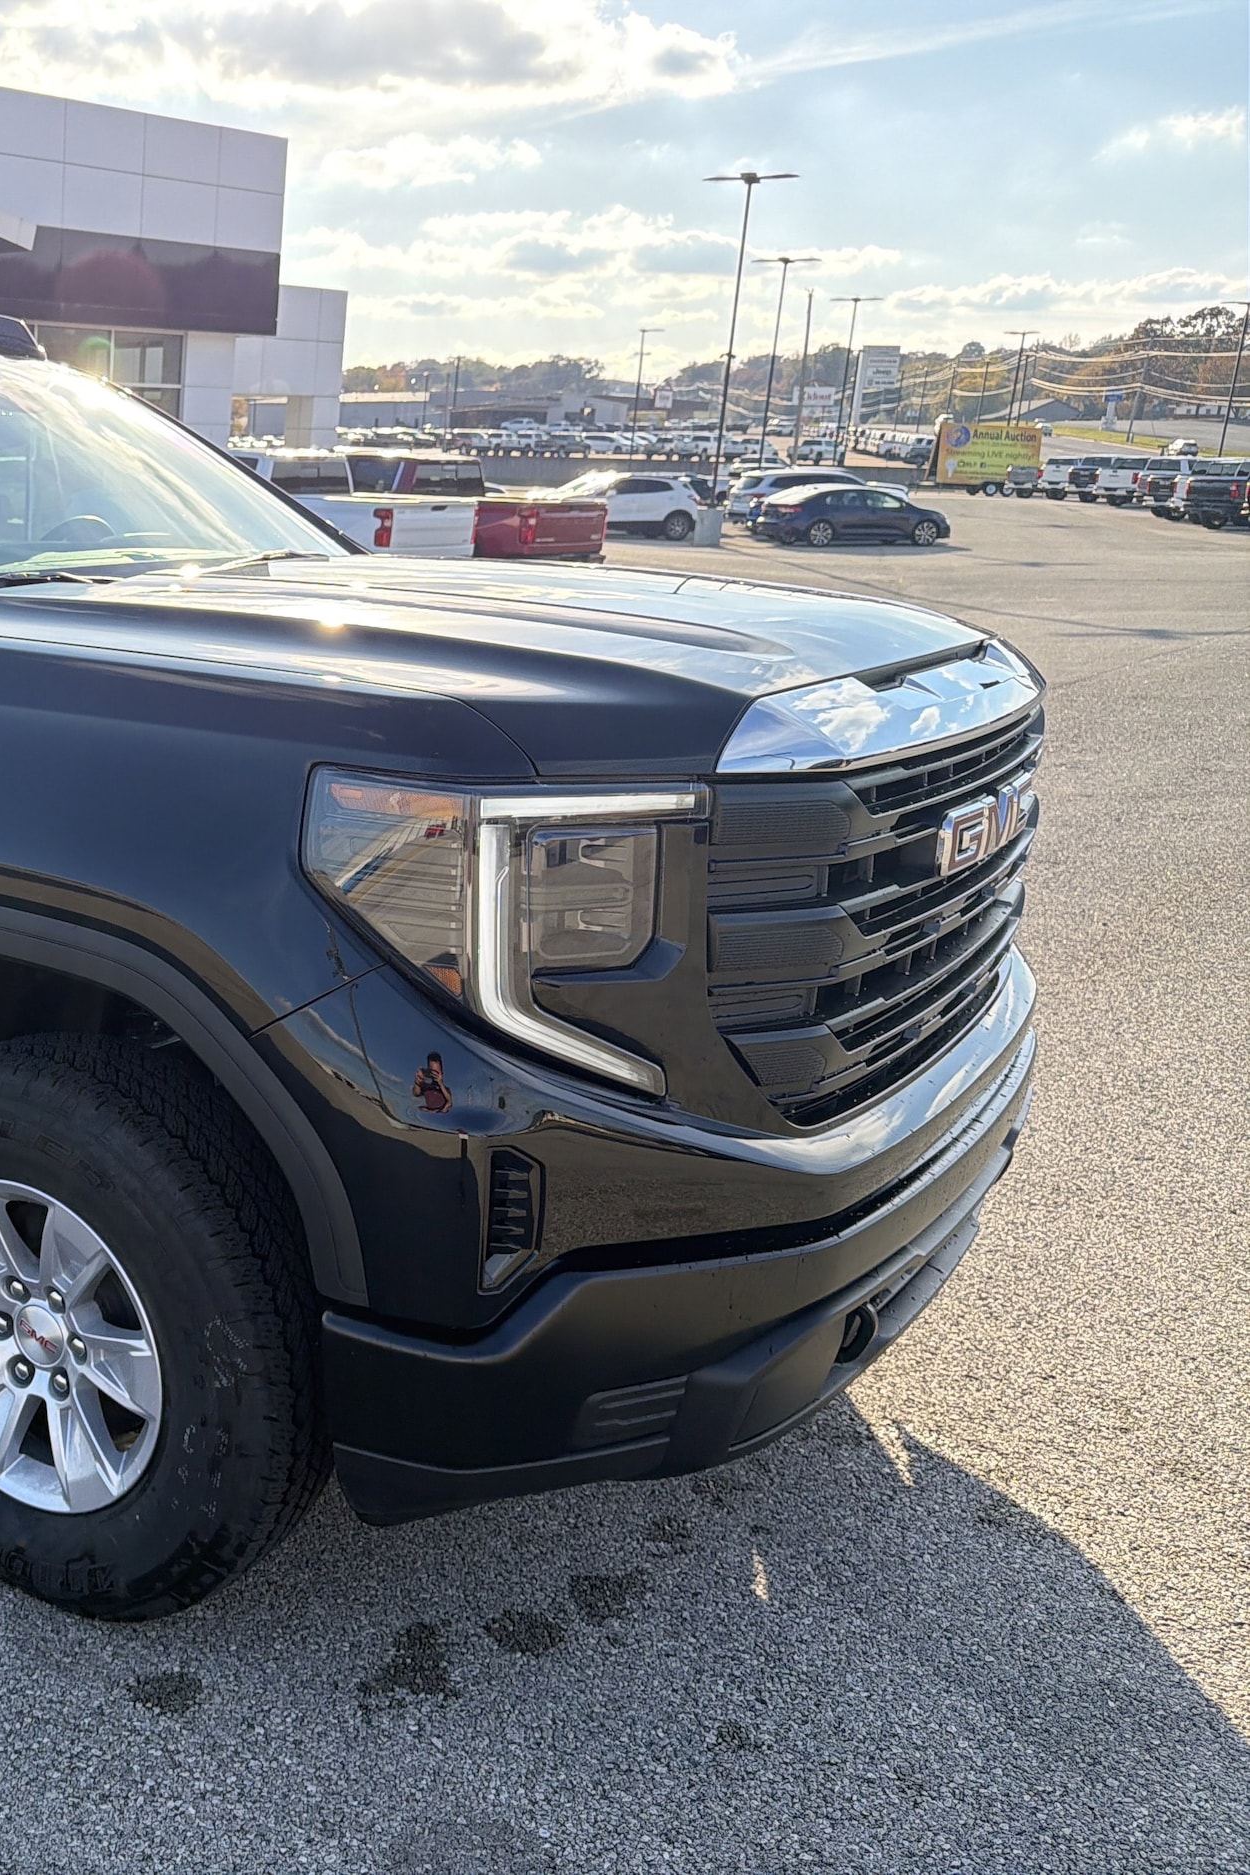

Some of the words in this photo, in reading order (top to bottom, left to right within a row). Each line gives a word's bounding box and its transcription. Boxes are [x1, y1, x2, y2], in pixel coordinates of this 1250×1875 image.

[972, 429, 1002, 440] Annual
[1004, 430, 1037, 442] Auction
[945, 449, 985, 459] Streaming
[987, 450, 1004, 459] LIVE
[936, 772, 1033, 876] GMC
[18, 1317, 59, 1355] GMC
